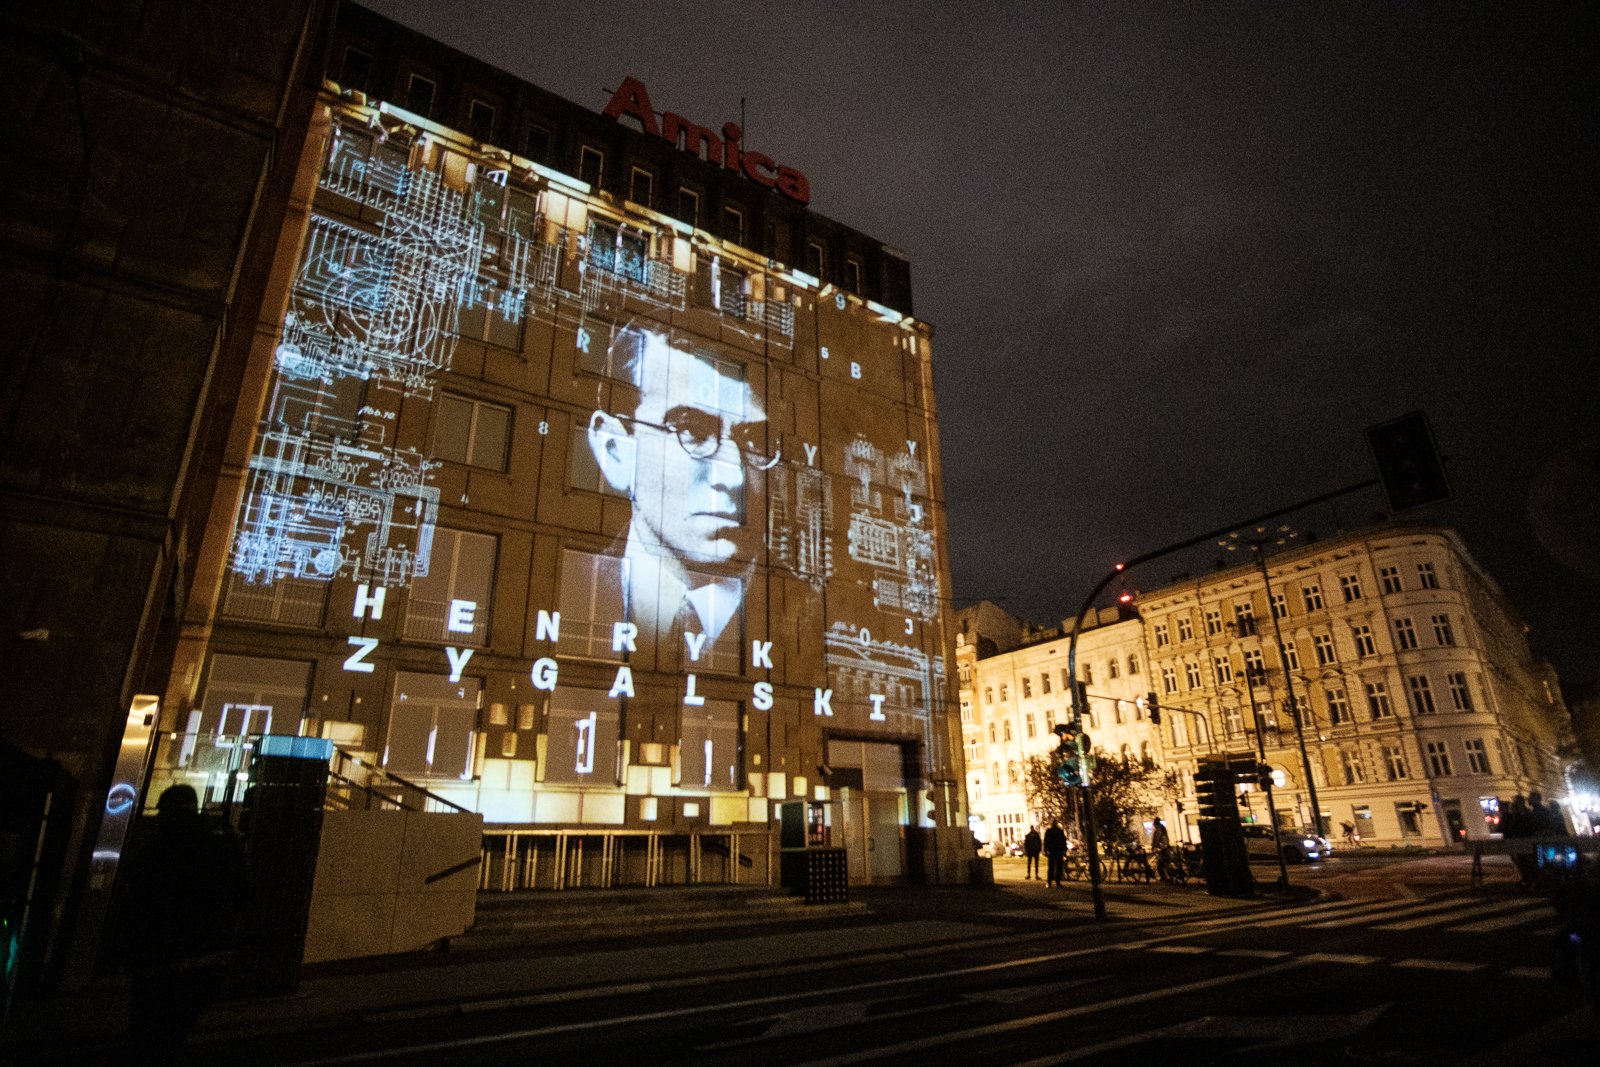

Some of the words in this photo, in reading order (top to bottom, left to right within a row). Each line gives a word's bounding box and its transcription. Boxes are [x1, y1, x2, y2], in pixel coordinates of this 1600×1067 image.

[602, 77, 810, 206] Amica
[576, 327, 590, 353] R
[803, 442, 817, 465] Y
